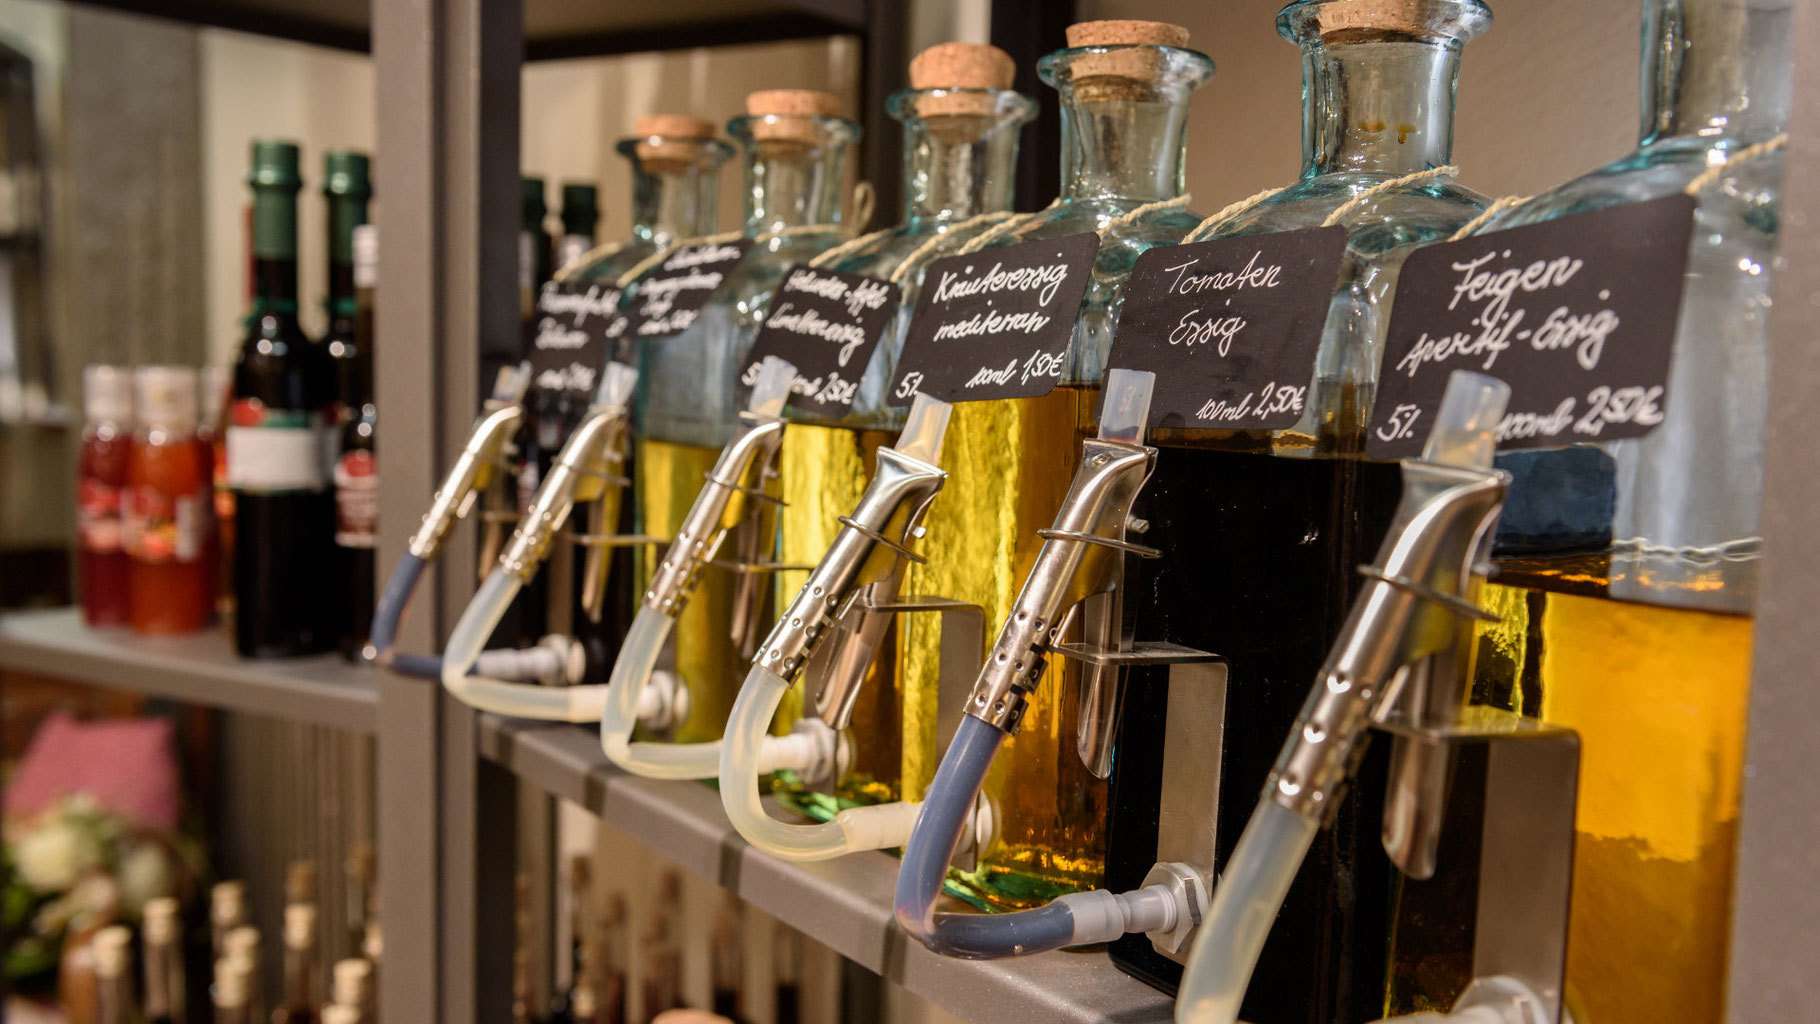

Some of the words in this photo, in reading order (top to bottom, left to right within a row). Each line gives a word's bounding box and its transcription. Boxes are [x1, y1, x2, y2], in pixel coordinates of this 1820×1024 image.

[1165, 250, 1282, 295] Tomaten
[1448, 249, 1584, 326] Feigen
[1168, 299, 1247, 357] Essig
[1196, 392, 1254, 421] 100ml
[1252, 381, 1307, 420] 2,50€
[1573, 385, 1664, 437] 2,50€
